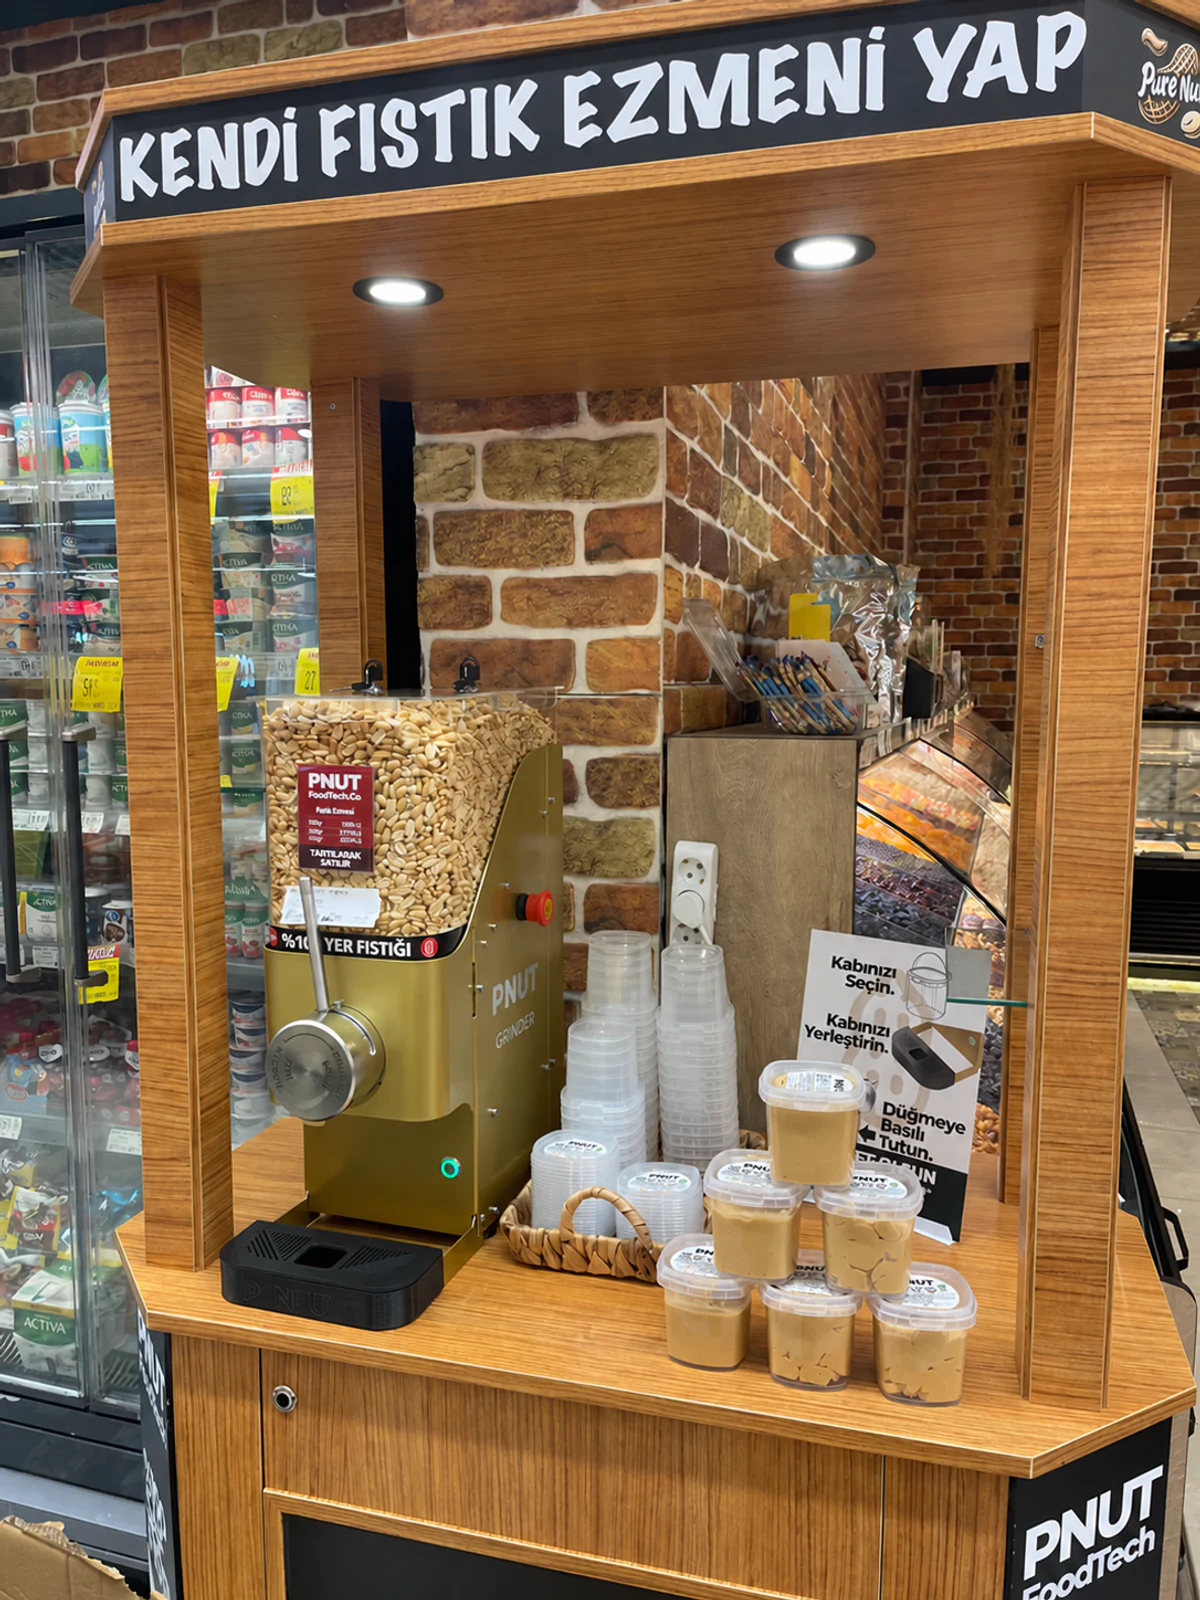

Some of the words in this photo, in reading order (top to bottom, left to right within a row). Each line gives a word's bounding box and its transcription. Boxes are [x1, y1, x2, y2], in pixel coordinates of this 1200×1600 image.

[1138, 61, 1178, 98] Pure
[119, 107, 299, 202] KENDİ
[318, 79, 541, 178] FISTIK
[564, 26, 886, 149] EZMENİ
[913, 11, 1088, 103] YAP
[308, 772, 363, 791] PNUT
[324, 937, 354, 954] YER
[357, 938, 411, 957] FISTIĞI
[831, 955, 897, 979] Kabınızı
[492, 962, 538, 1016] PNUT
[845, 974, 895, 995] Seçin.
[495, 1011, 535, 1049] GRINDER
[805, 1024, 889, 1054] Yerleştirin.
[826, 1013, 891, 1038] Kabınızı
[881, 1118, 925, 1142] Basılı
[882, 1101, 966, 1135] Düğmeye
[879, 1134, 933, 1162] Tutun.
[23, 1316, 67, 1335] ACTIVA
[1023, 1464, 1164, 1582] PNUT
